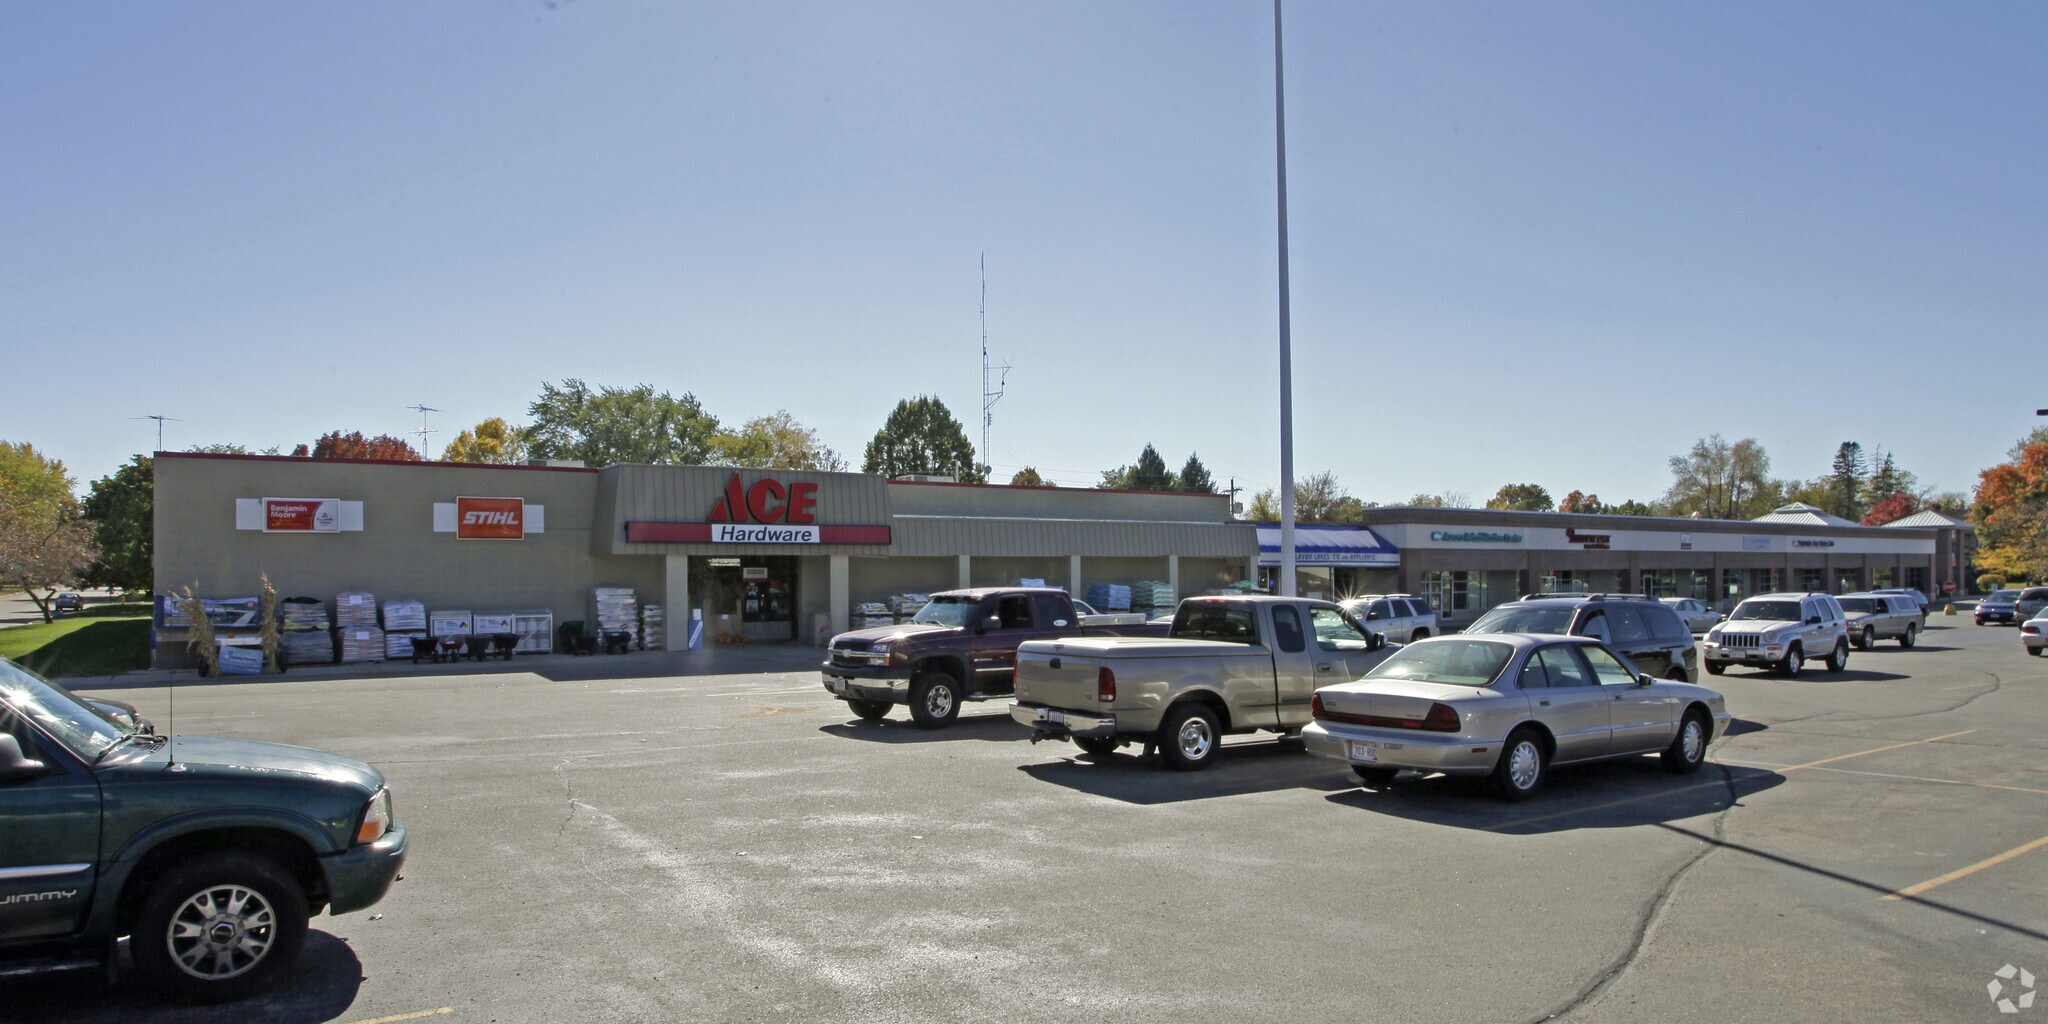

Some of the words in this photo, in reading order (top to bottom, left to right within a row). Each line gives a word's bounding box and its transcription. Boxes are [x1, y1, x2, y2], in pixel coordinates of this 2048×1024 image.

[706, 471, 819, 524] ACE
[270, 504, 307, 513] Benjamin
[463, 511, 519, 525] STIHL
[720, 526, 812, 542] Hardware
